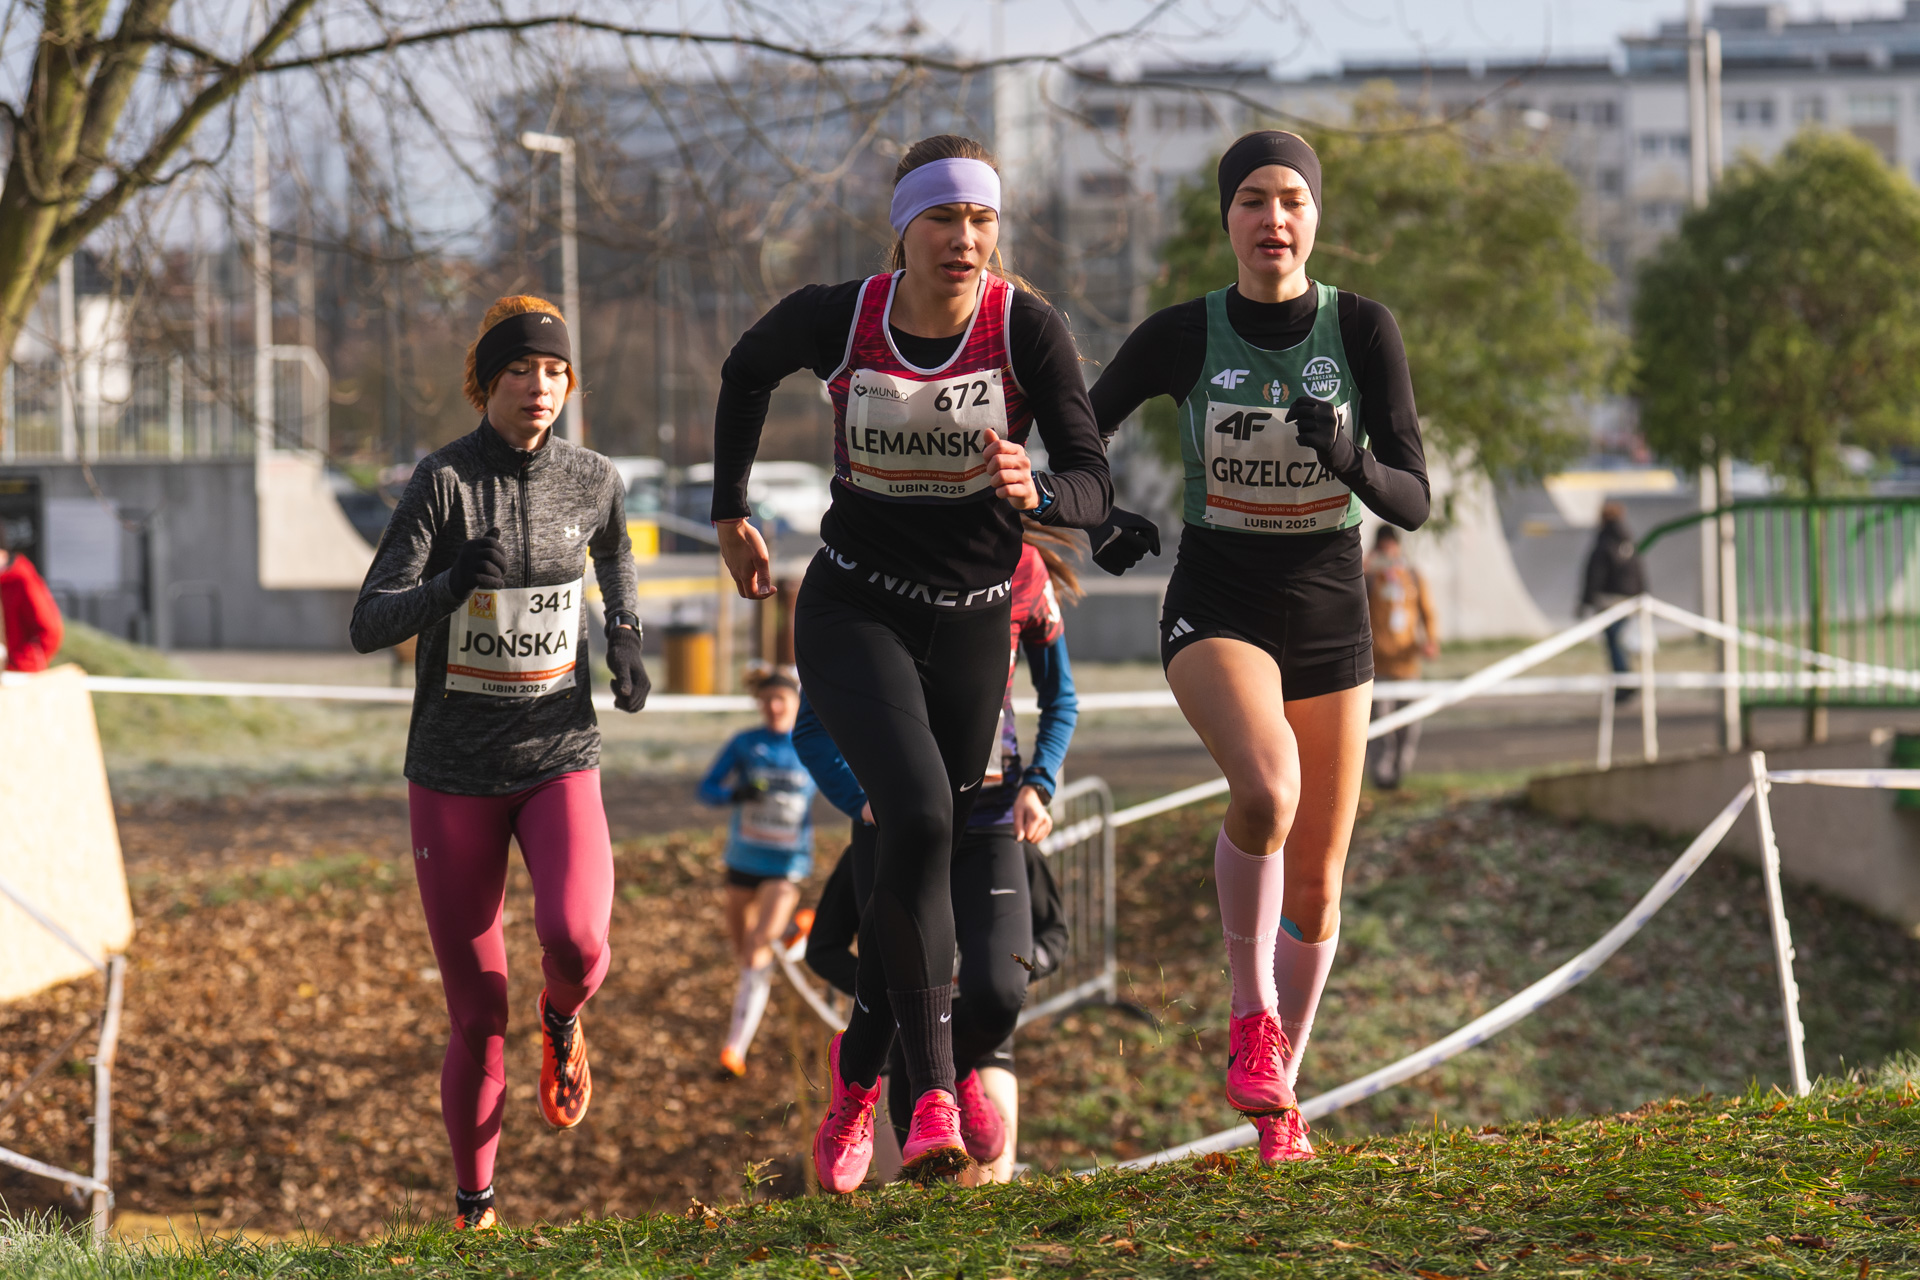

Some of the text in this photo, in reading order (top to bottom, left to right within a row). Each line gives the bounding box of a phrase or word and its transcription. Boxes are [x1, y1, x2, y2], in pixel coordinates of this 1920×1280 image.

[1310, 363, 1332, 375] AZS
[1210, 368, 1251, 390] 4F
[1310, 379, 1335, 392] AWF
[868, 386, 909, 401] MUNDO
[934, 380, 990, 412] 672
[1214, 411, 1273, 441] 4F
[888, 483, 966, 495] LUBIN 2025
[1220, 499, 1234, 507] PZLA
[1234, 502, 1267, 512] Mistrzostwa
[1292, 504, 1315, 514] Biegach
[1244, 517, 1317, 530] LUBIN 2025
[867, 571, 959, 607] NIKE
[529, 589, 572, 614] 341
[459, 629, 568, 658] JOŃSKA
[482, 682, 548, 694] LUBIN 2025
